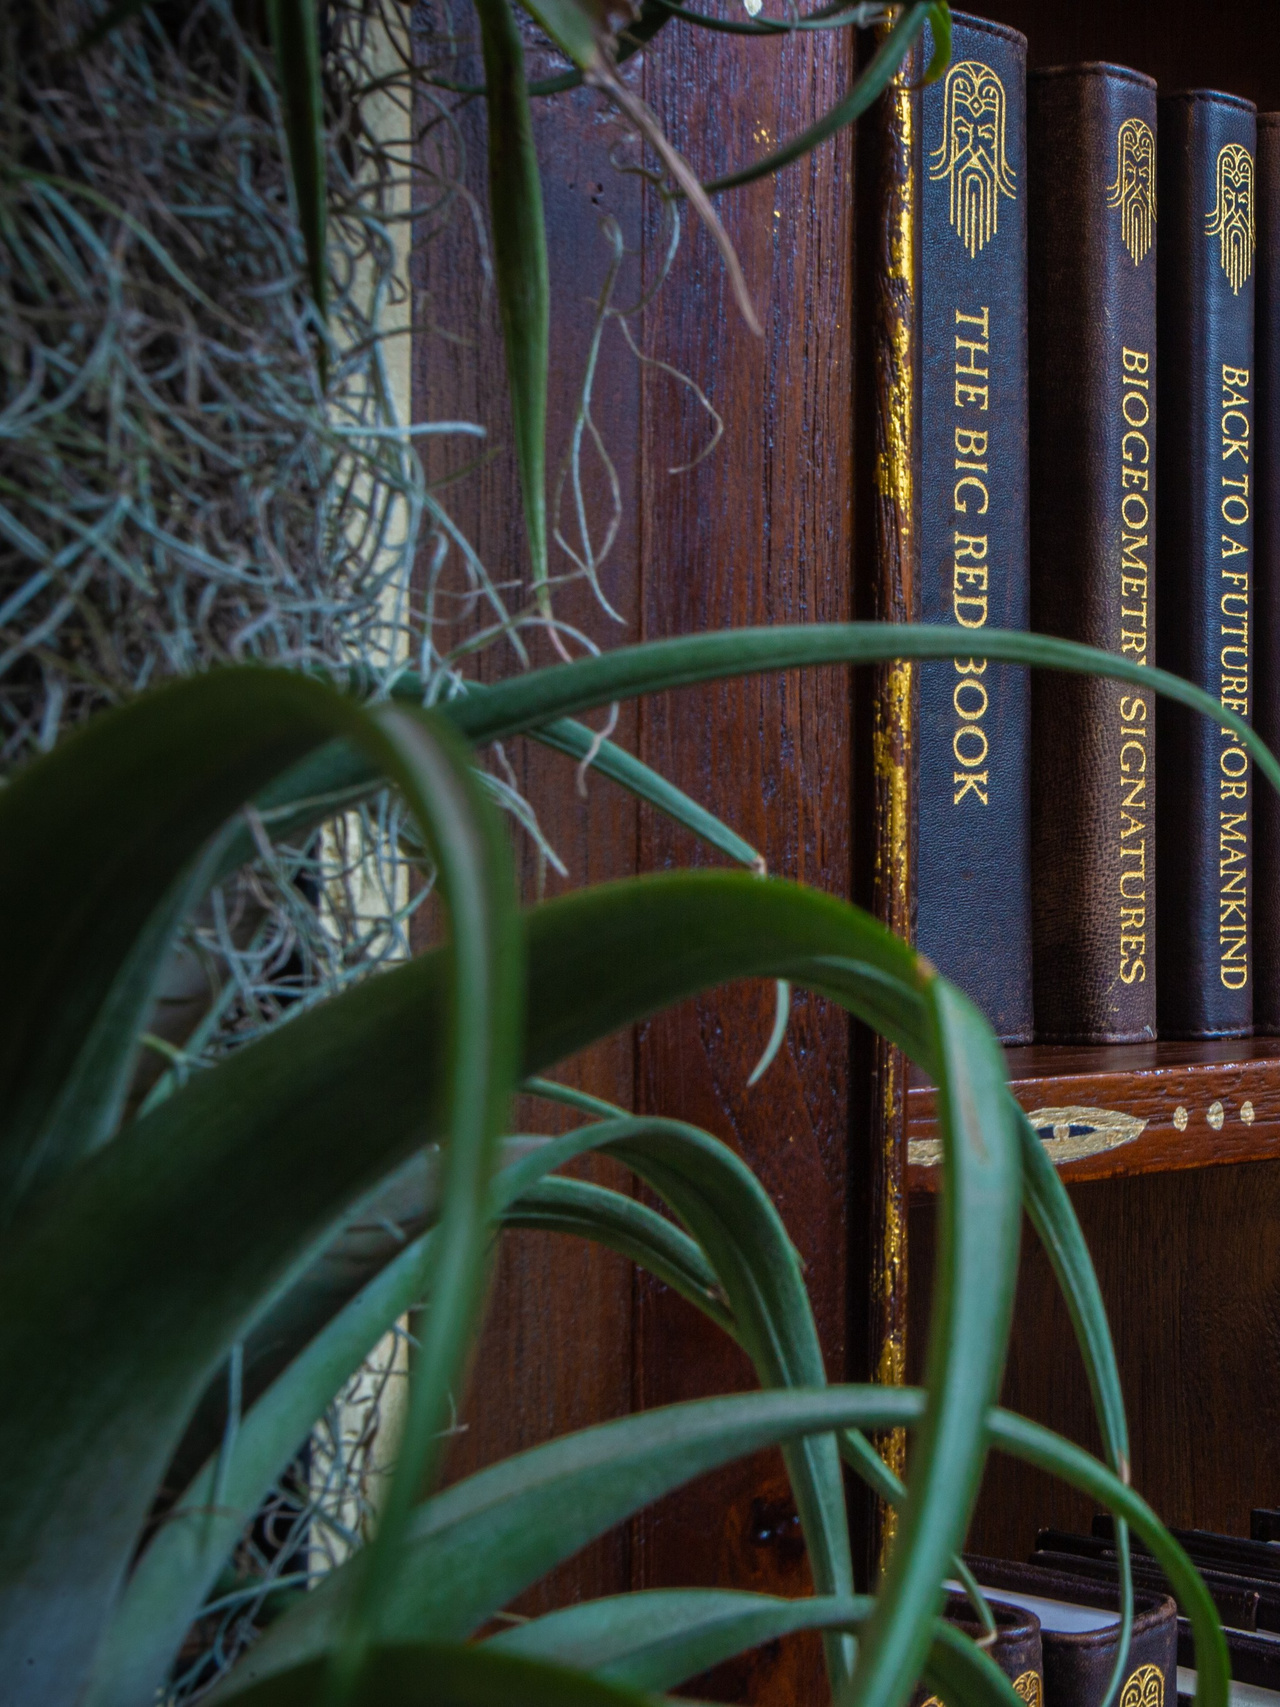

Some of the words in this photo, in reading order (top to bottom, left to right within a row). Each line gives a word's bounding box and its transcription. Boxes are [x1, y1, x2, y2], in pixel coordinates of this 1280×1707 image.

[955, 307, 989, 410] THE
[1222, 364, 1250, 460] BACK
[954, 428, 988, 514] BIG
[1121, 347, 1149, 666] BIOGEOMETR
[1222, 475, 1248, 525] TO
[953, 531, 988, 629] RED
[1222, 535, 1248, 558] A
[1221, 570, 1248, 715] FUTURE
[1221, 728, 1247, 800] FOR
[1120, 696, 1146, 984] SIGNATURES
[1220, 812, 1247, 989] MANKIND
